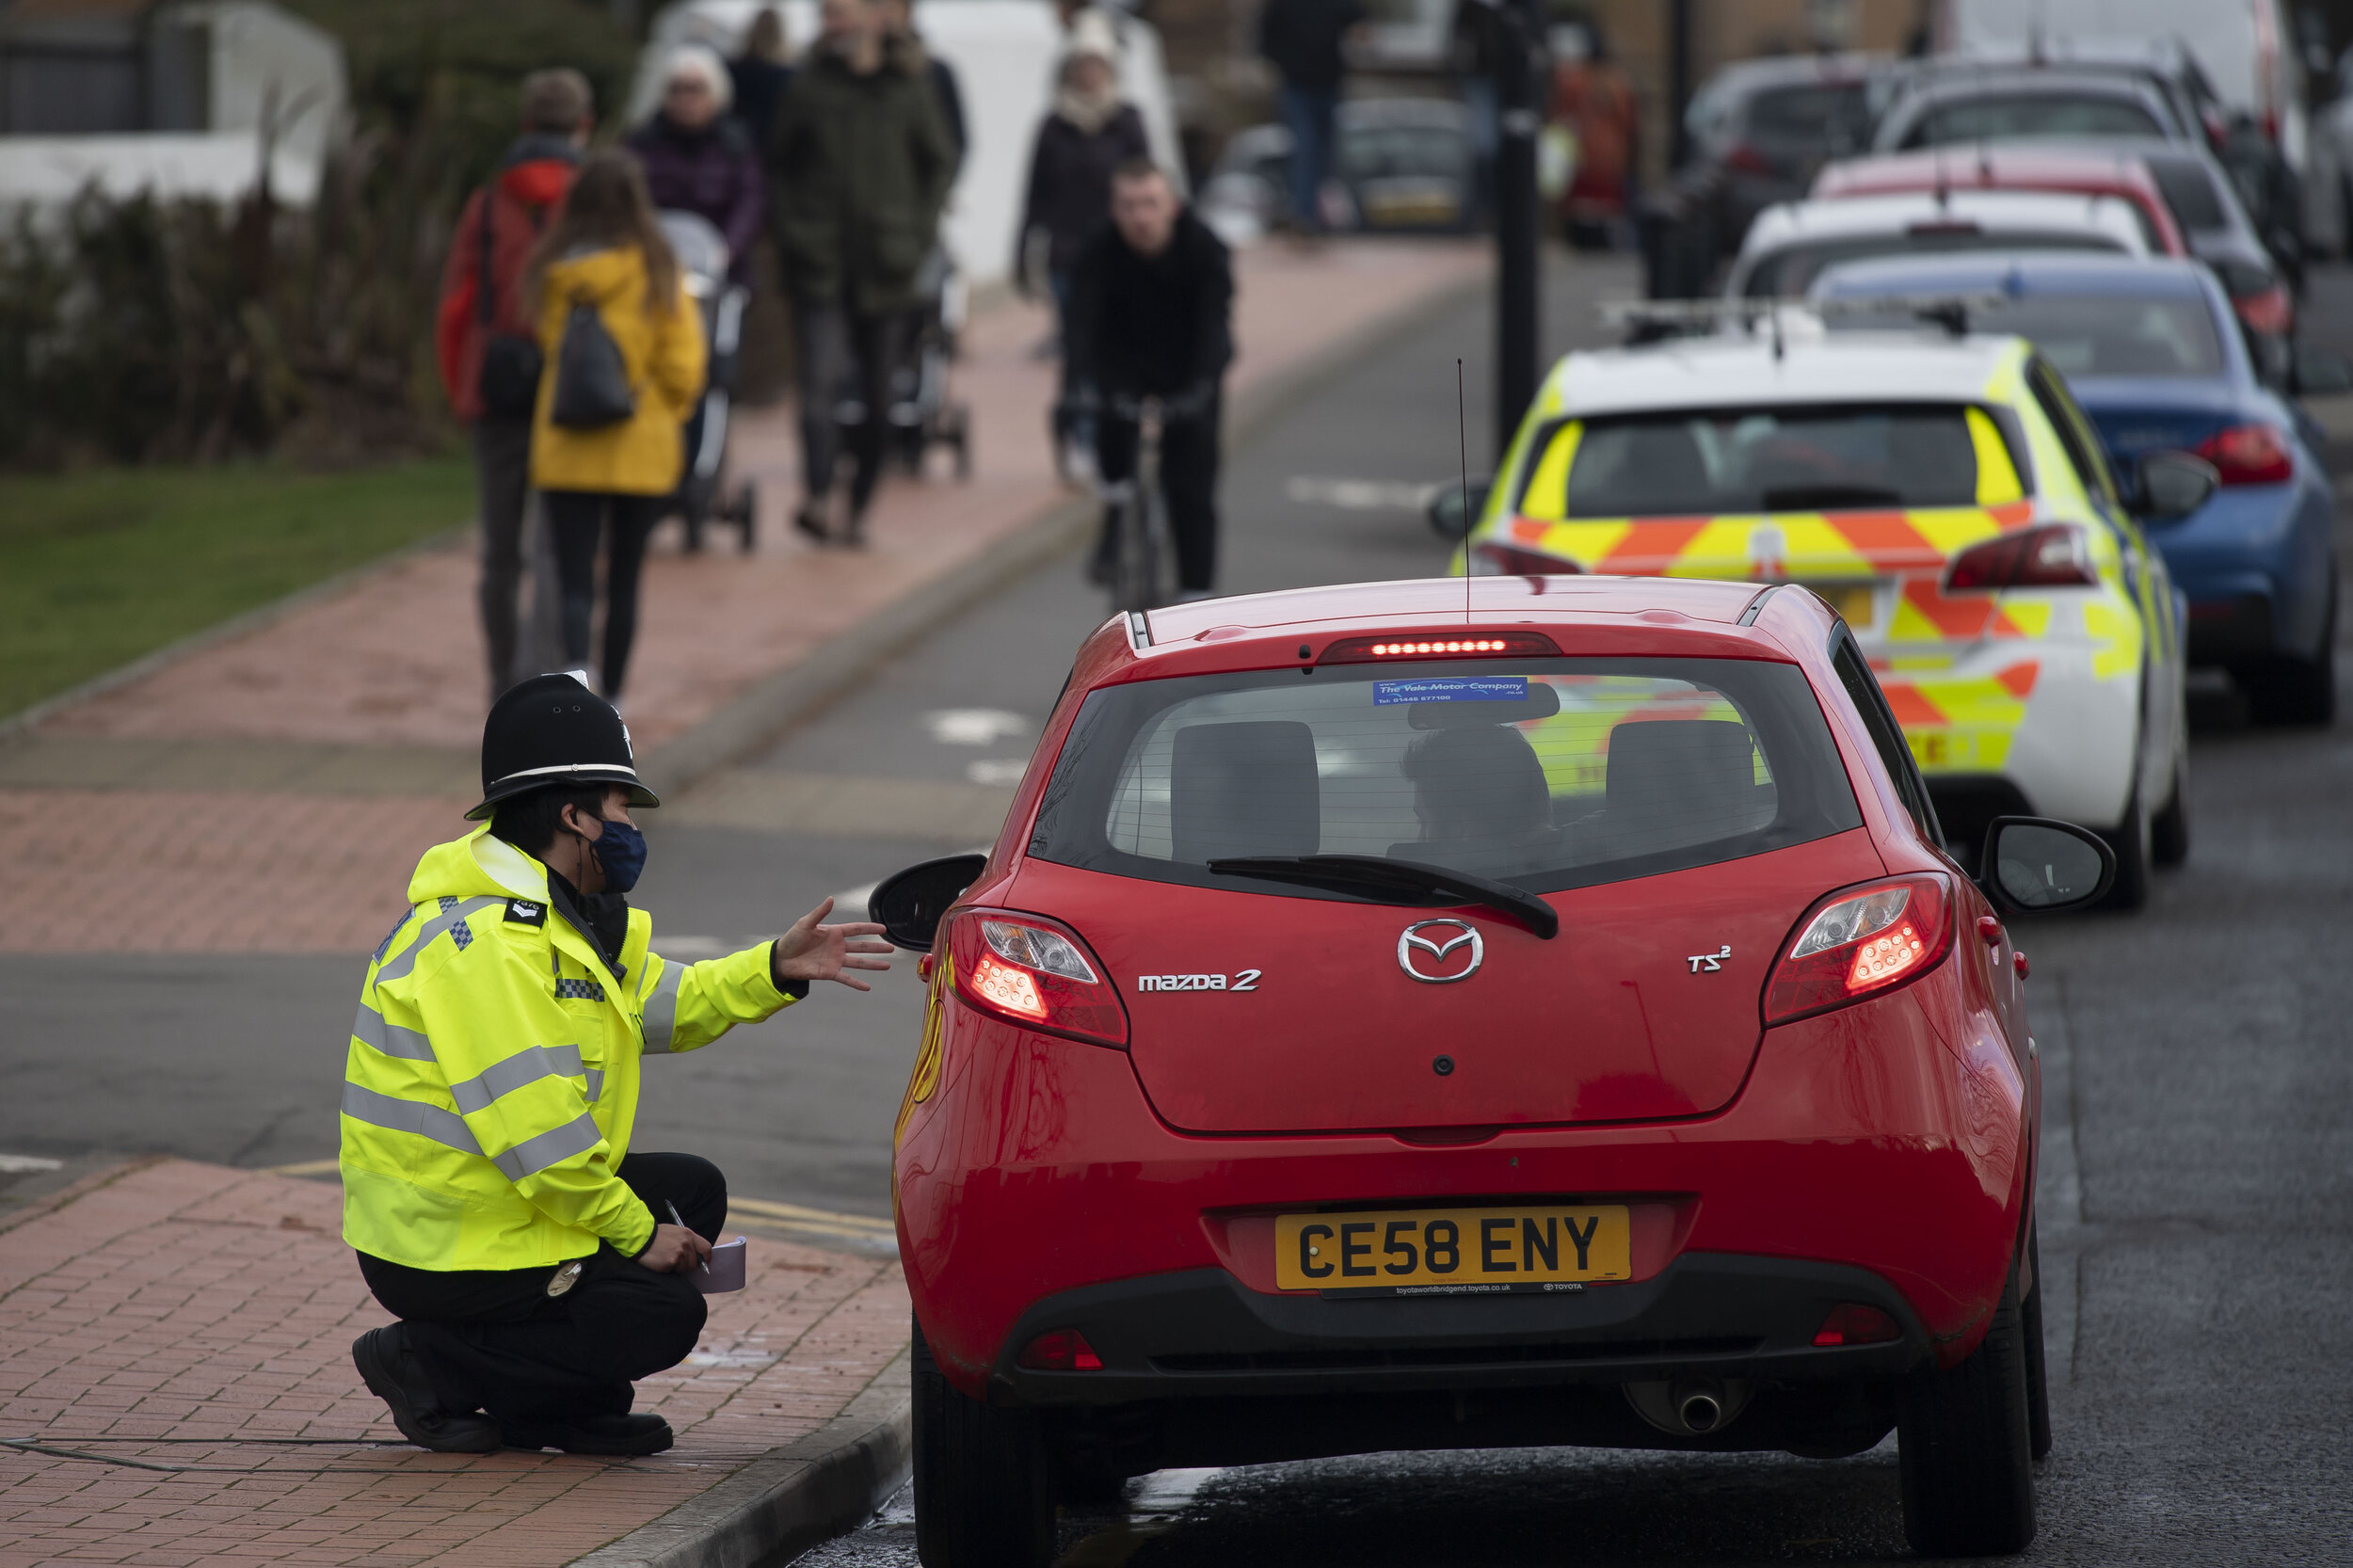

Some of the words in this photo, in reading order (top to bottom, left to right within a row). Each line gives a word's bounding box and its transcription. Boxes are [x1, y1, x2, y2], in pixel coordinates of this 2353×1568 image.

[1469, 682, 1522, 691] Company
[1299, 1220, 1460, 1278] CE58
[1481, 1216, 1599, 1272] ENY
[1397, 1284, 1511, 1294] toyotaworldbridgend.toyota.co.uk
